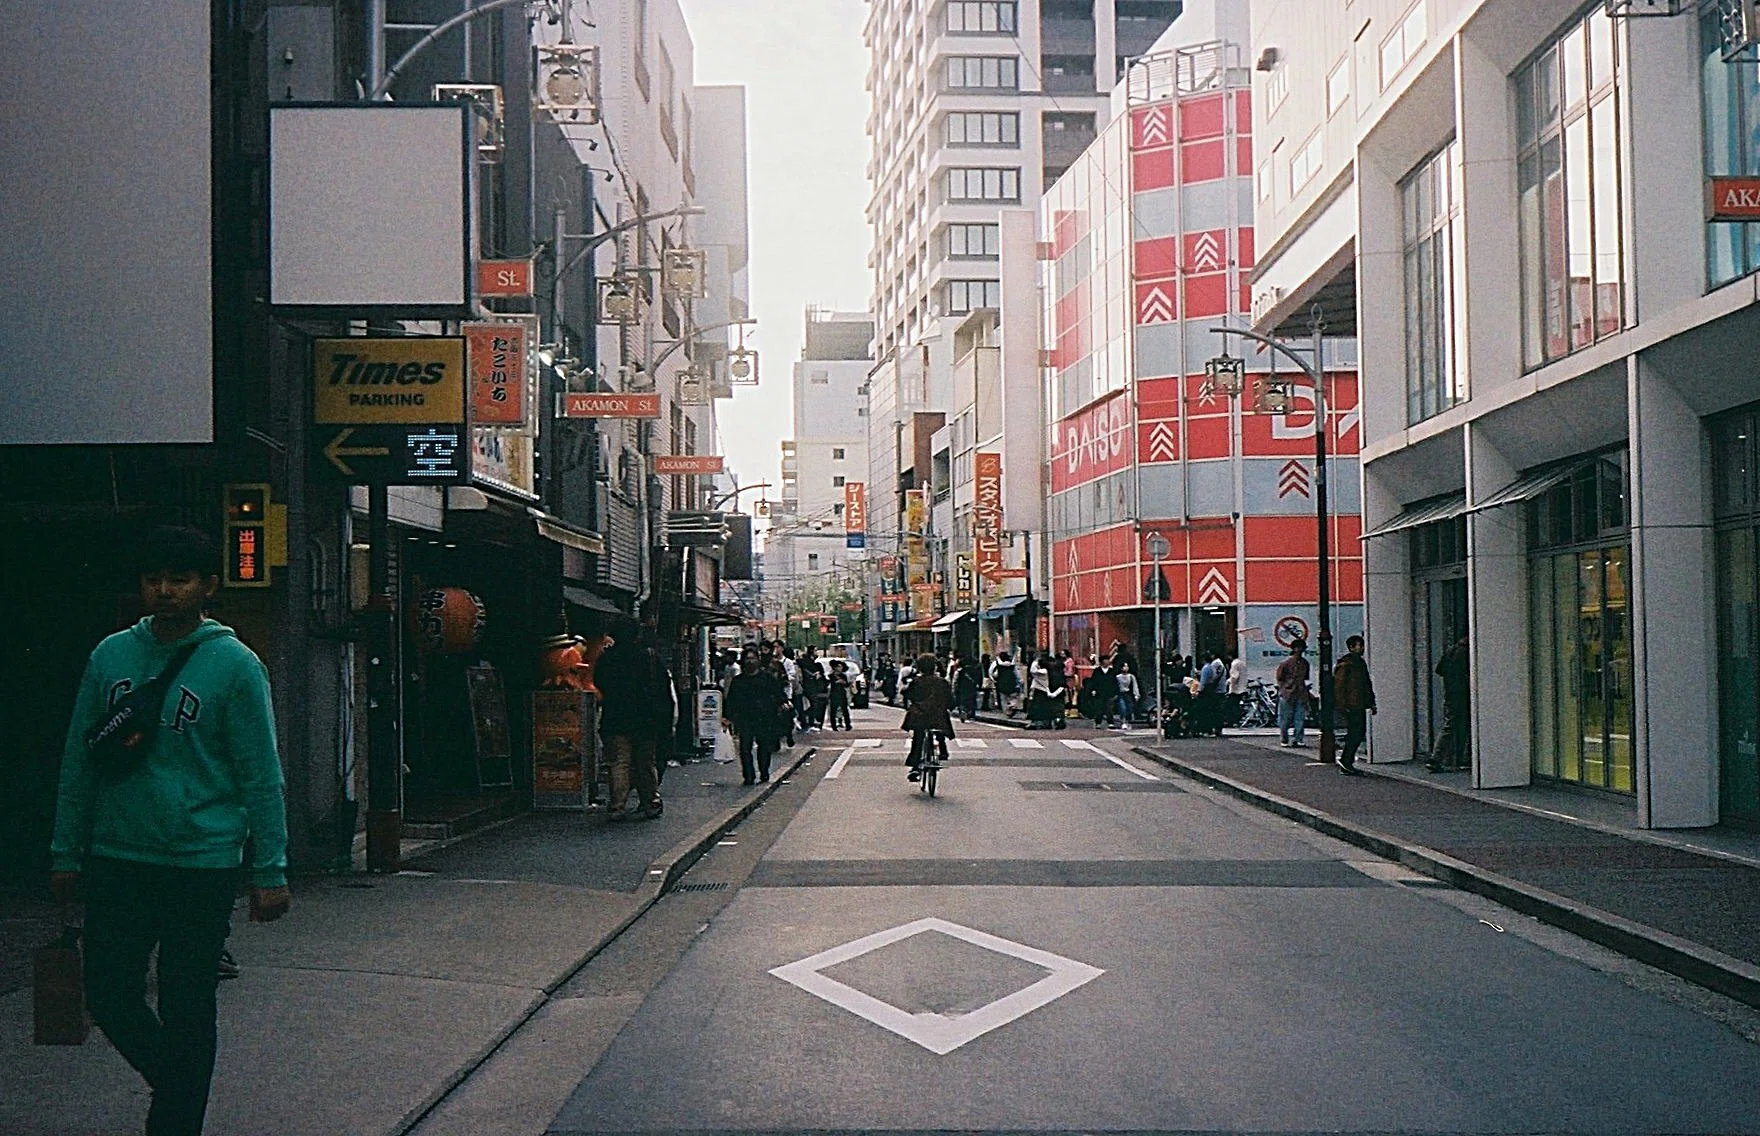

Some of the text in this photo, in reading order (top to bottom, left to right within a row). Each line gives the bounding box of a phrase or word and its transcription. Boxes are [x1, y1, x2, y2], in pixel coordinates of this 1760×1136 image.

[497, 270, 520, 286] St.
[328, 353, 445, 385] Times
[491, 336, 508, 402] たこいち
[349, 392, 425, 407] PARKING
[572, 399, 628, 411] AKAMON
[407, 428, 458, 477] 空
[1068, 408, 1122, 473] DAISO
[660, 461, 699, 470] AKAMON
